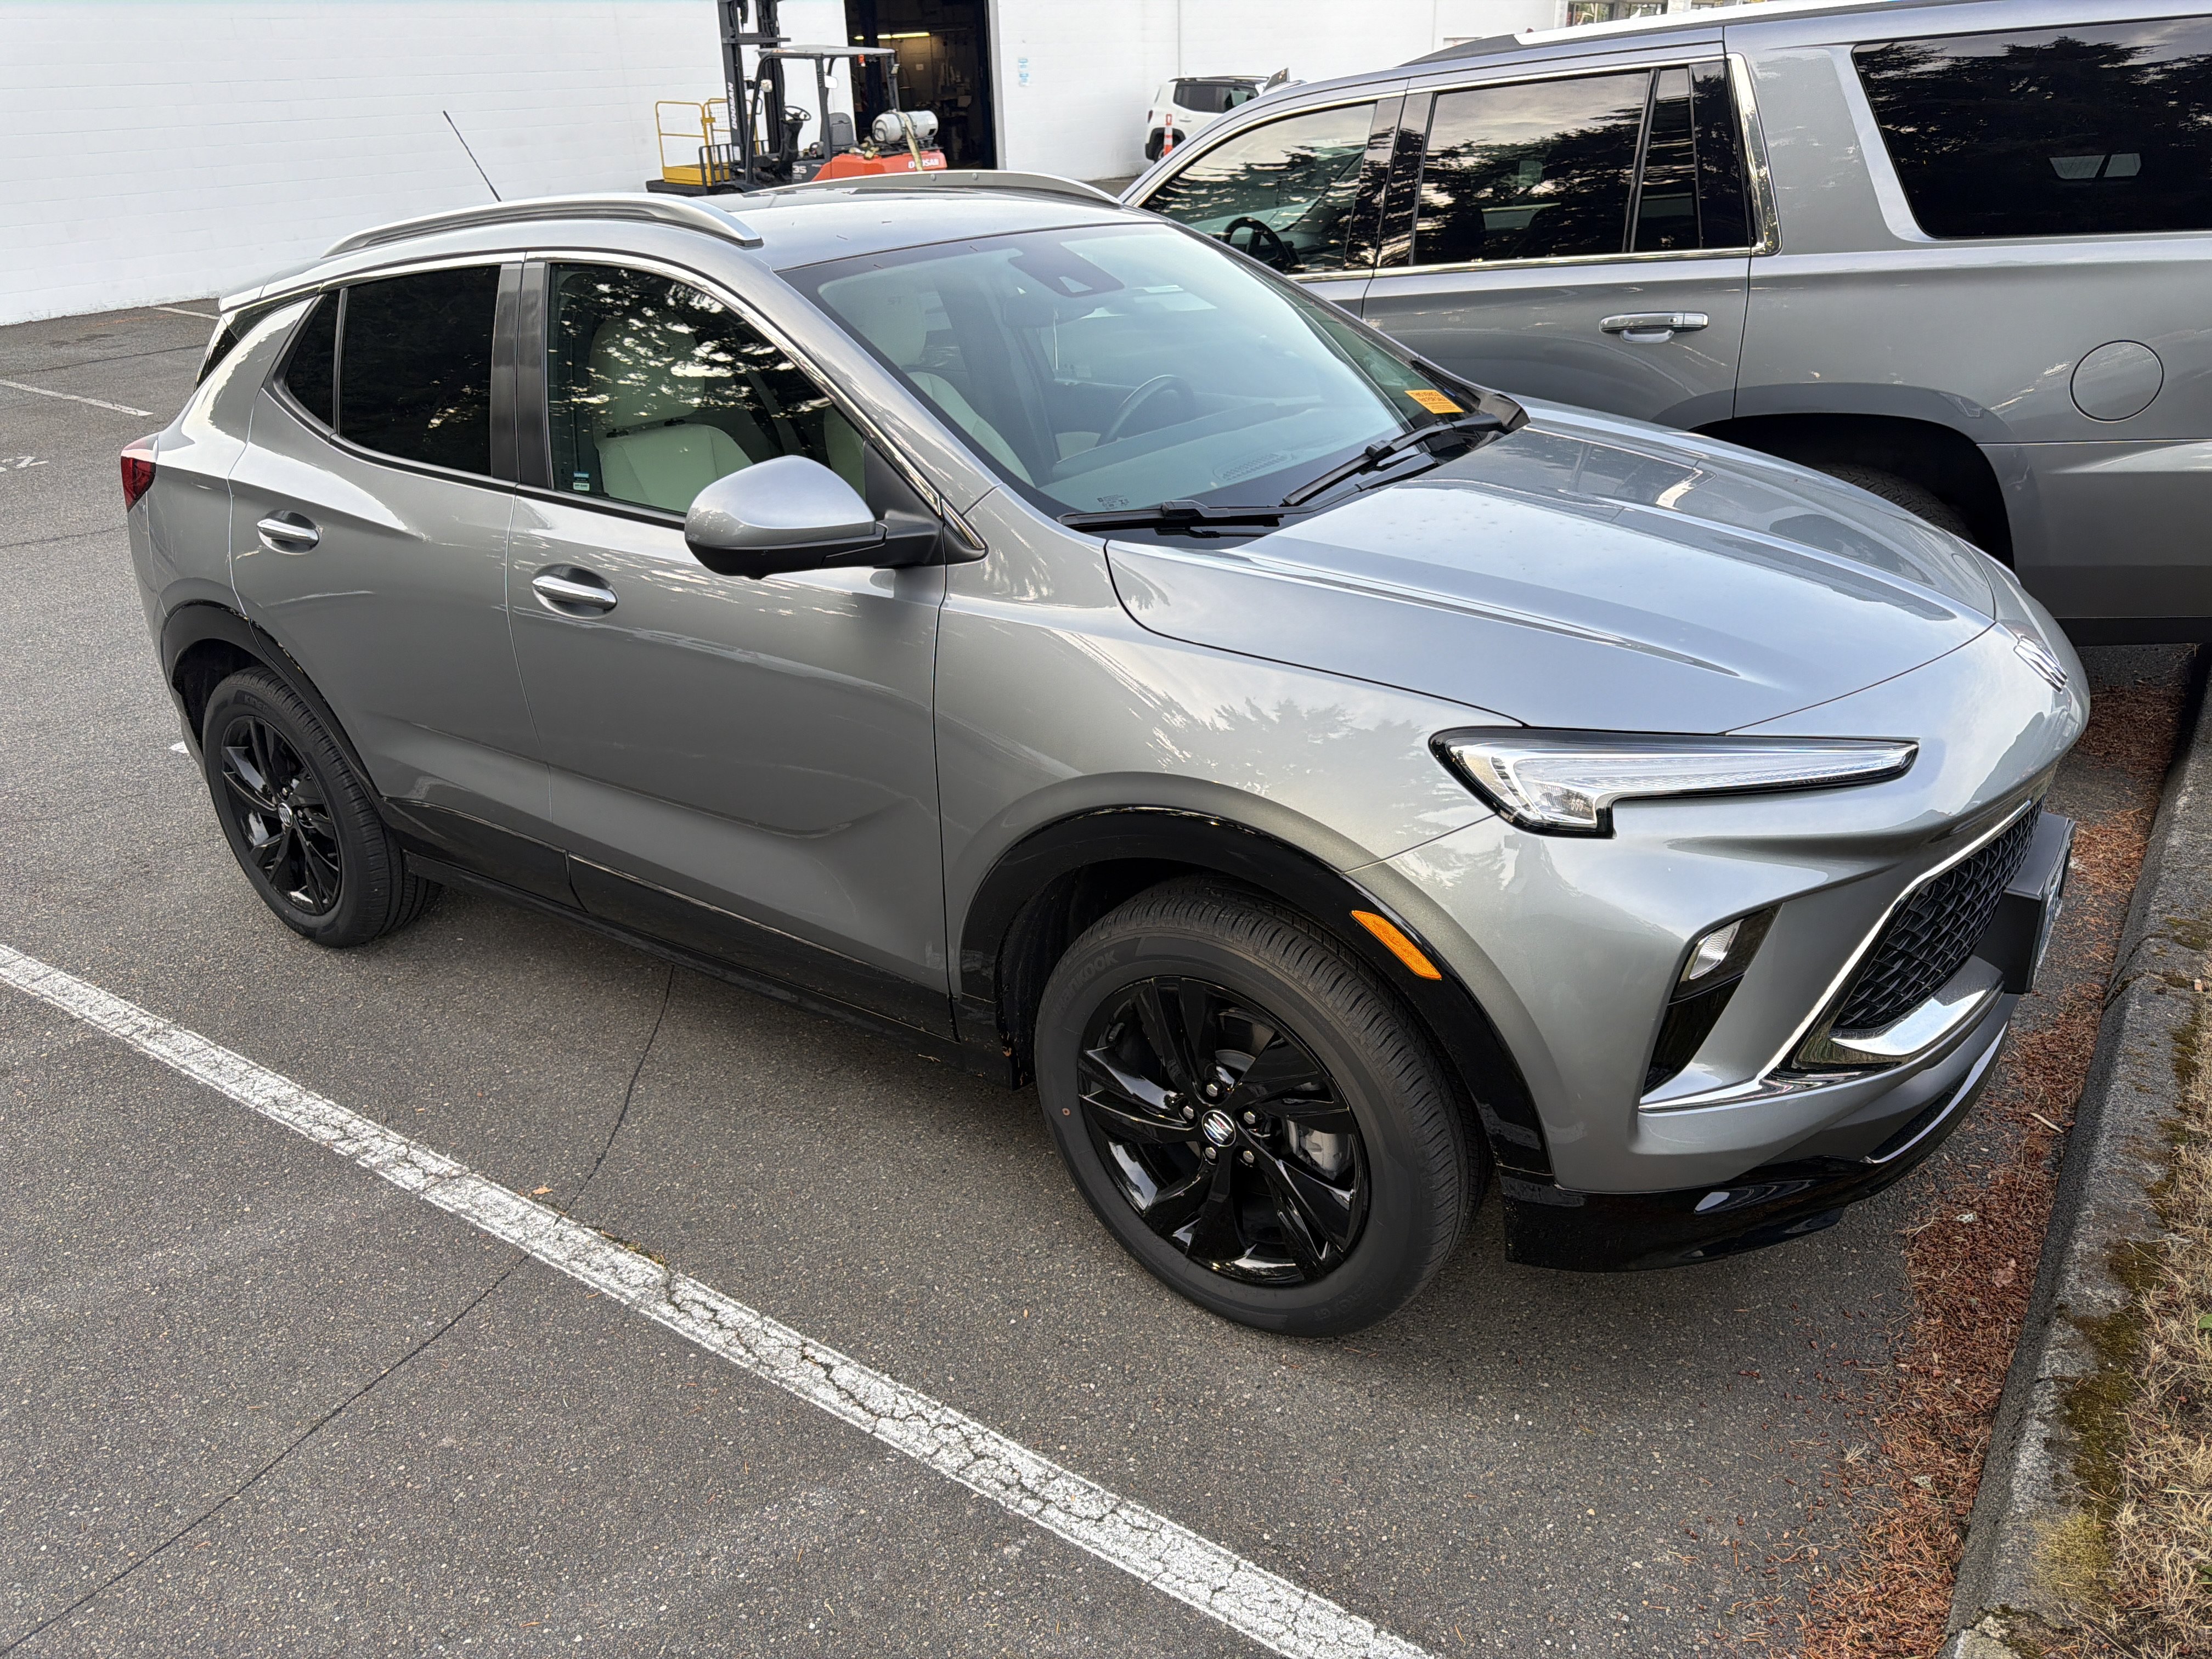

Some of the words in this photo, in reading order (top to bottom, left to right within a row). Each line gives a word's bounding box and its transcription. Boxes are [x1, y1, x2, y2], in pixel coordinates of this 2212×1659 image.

[727, 82, 738, 129] DOOSAN
[908, 159, 939, 169] DOSAN
[792, 165, 807, 174] 35
